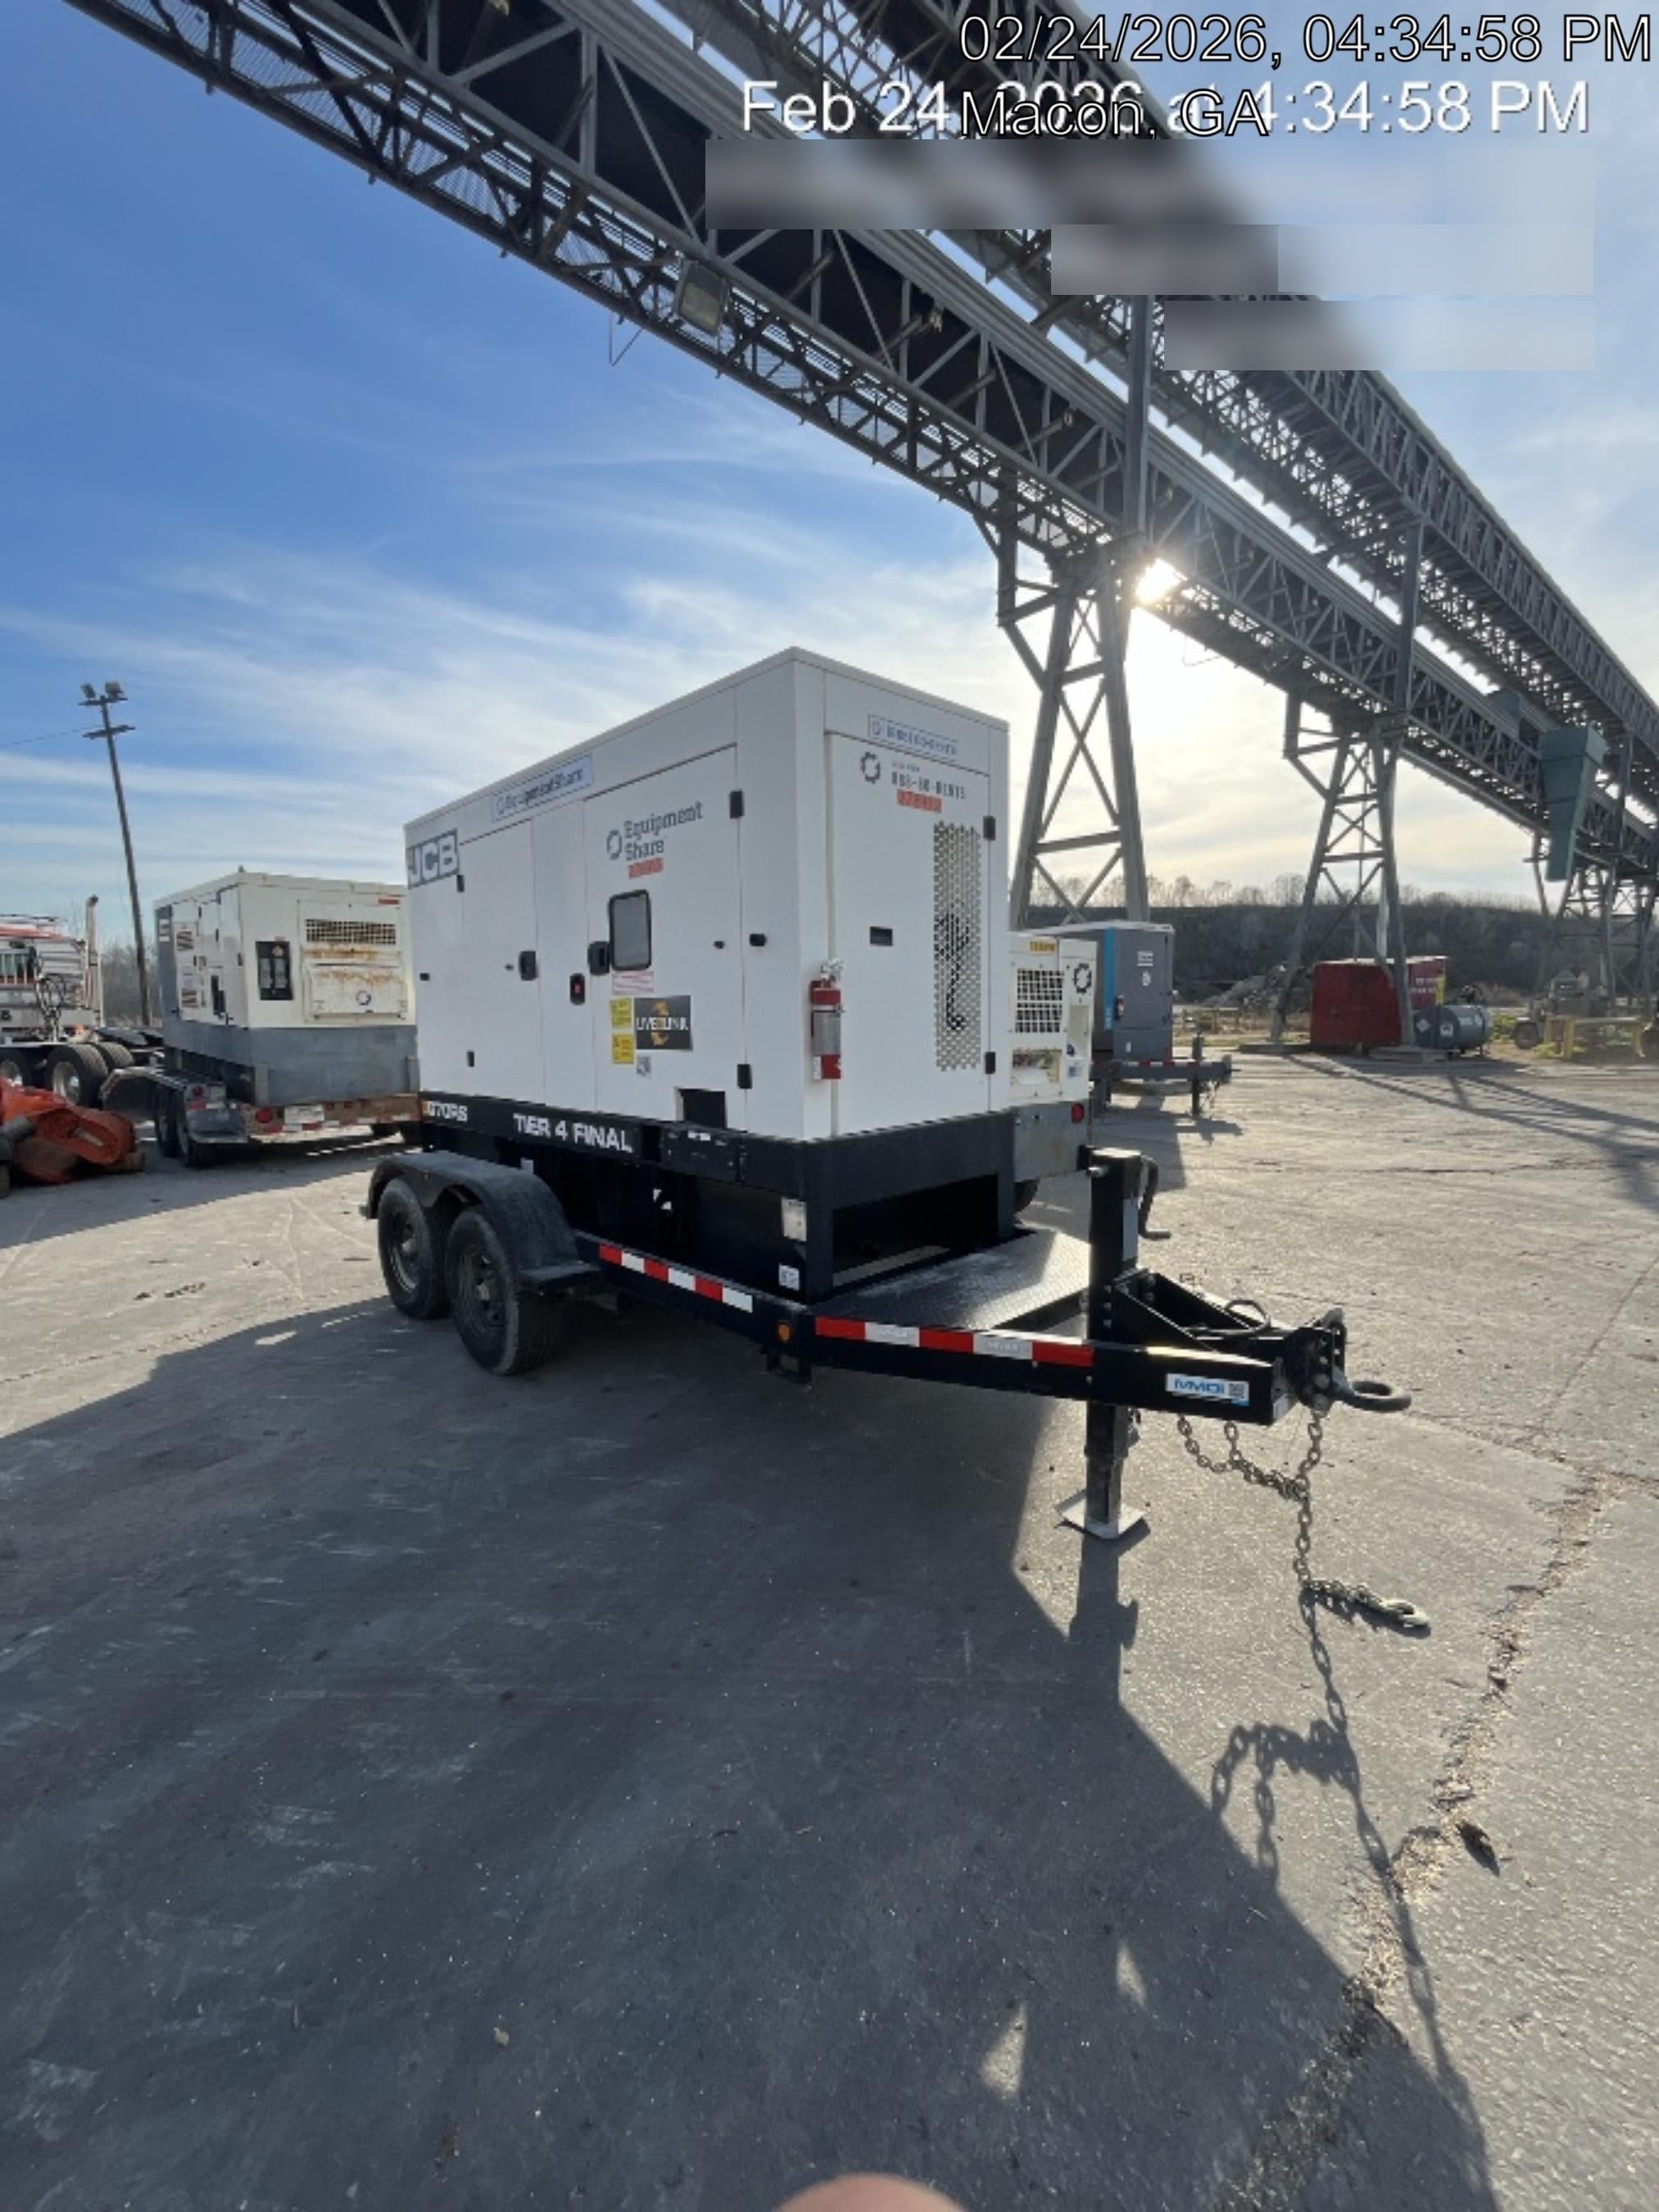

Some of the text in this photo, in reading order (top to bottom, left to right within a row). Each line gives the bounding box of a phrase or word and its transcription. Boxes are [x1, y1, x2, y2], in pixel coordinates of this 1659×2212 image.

[623, 800, 704, 841] Equipment
[406, 832, 460, 886] JCB
[625, 840, 664, 861] Share
[513, 1113, 633, 1154] TIER 4 FINAL
